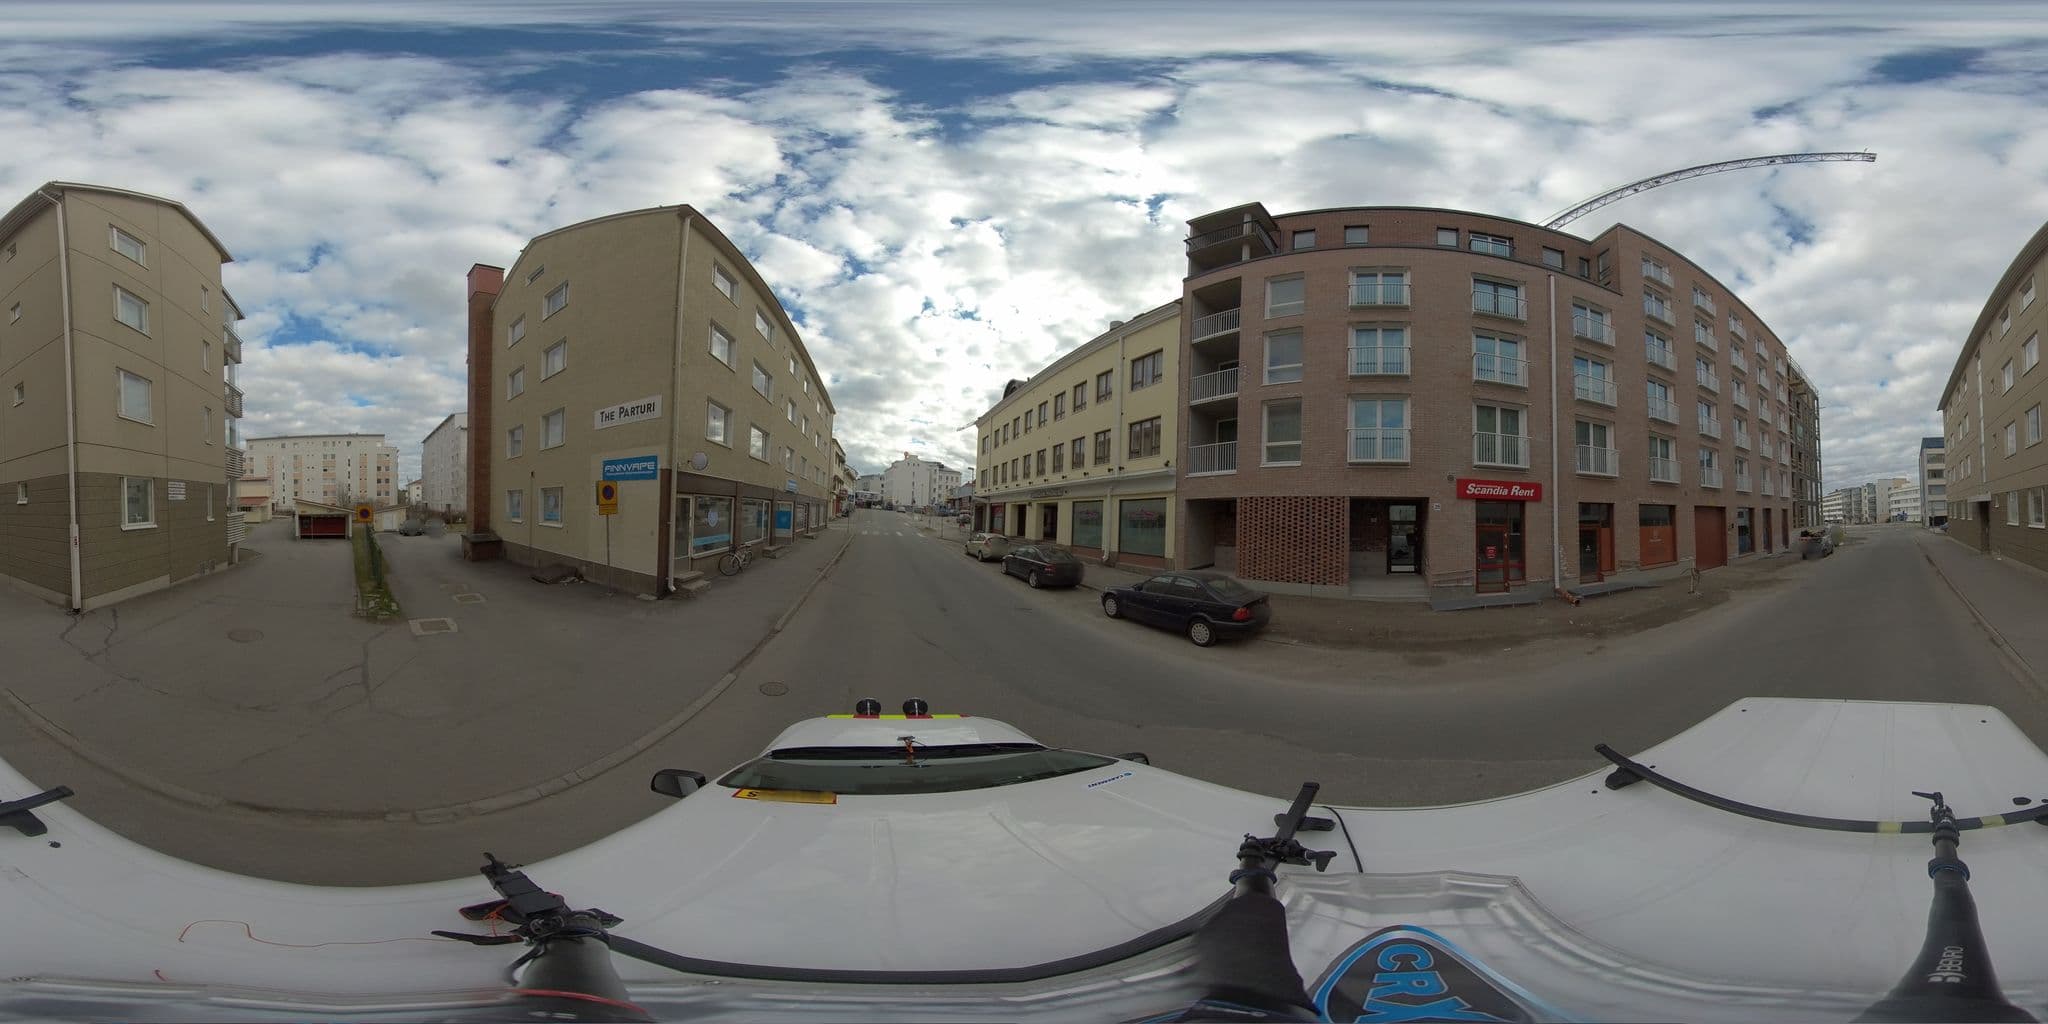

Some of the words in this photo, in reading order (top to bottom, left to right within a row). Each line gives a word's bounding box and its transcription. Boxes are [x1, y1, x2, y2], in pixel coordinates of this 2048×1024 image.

[600, 410, 616, 423] THE
[619, 402, 656, 419] PARTURI
[1466, 483, 1508, 496] Scandia
[1510, 485, 1534, 497] Rent
